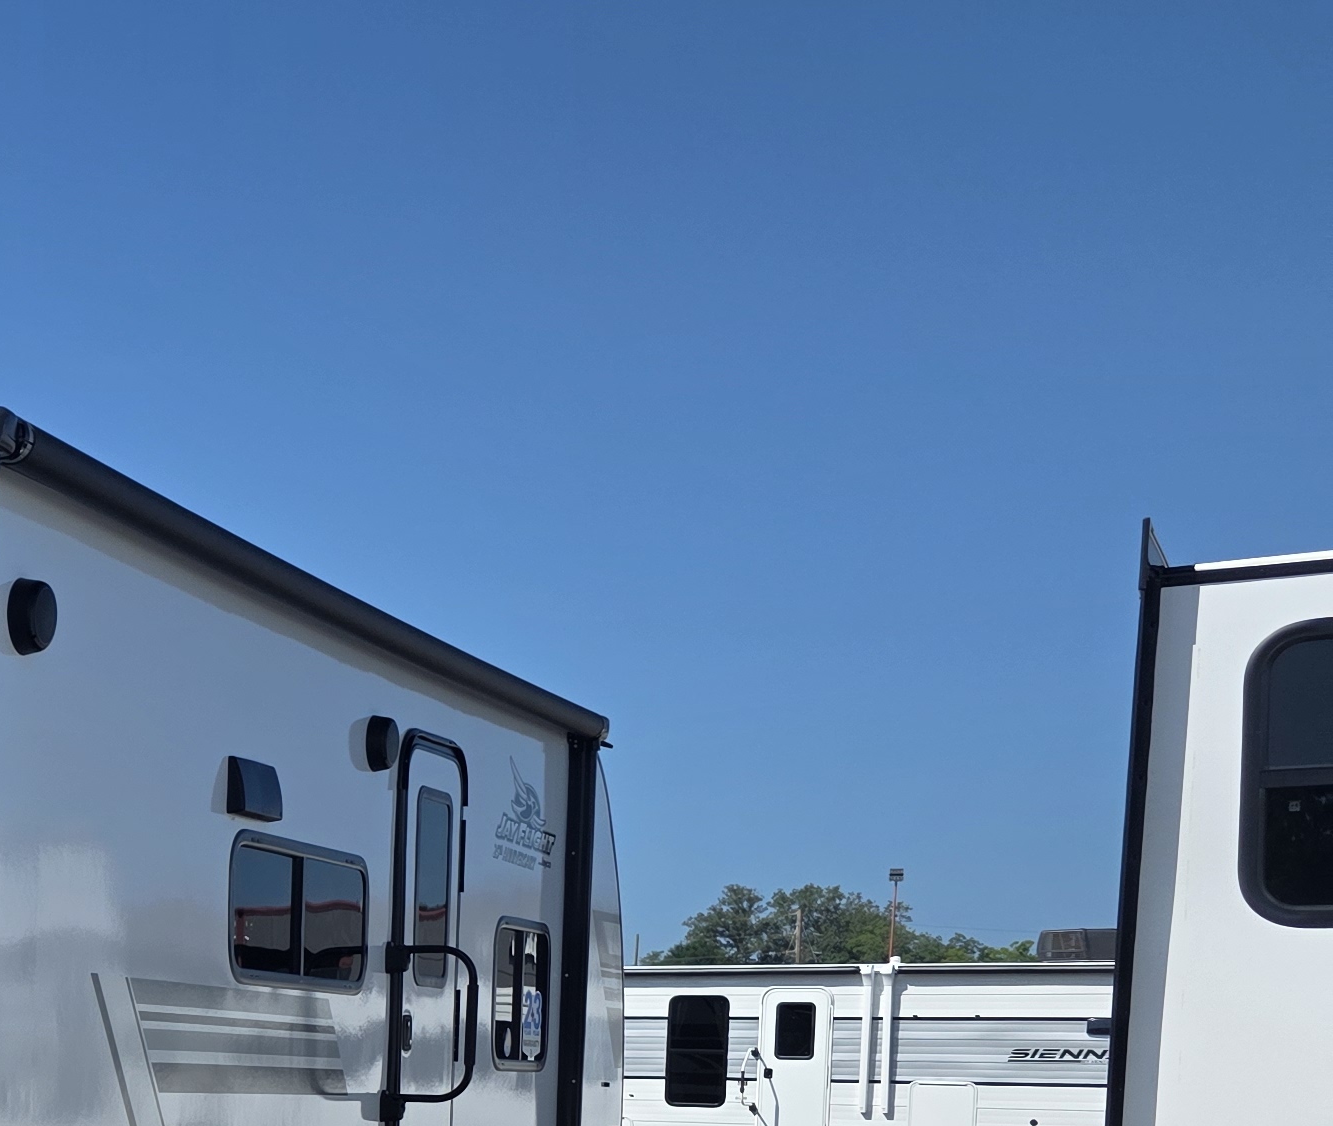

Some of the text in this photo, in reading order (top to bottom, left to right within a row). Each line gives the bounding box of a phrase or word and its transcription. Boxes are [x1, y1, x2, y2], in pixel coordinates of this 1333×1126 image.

[495, 813, 519, 842] JAY
[514, 821, 555, 855] FLIGHT
[1008, 1048, 1110, 1060] SIENN
